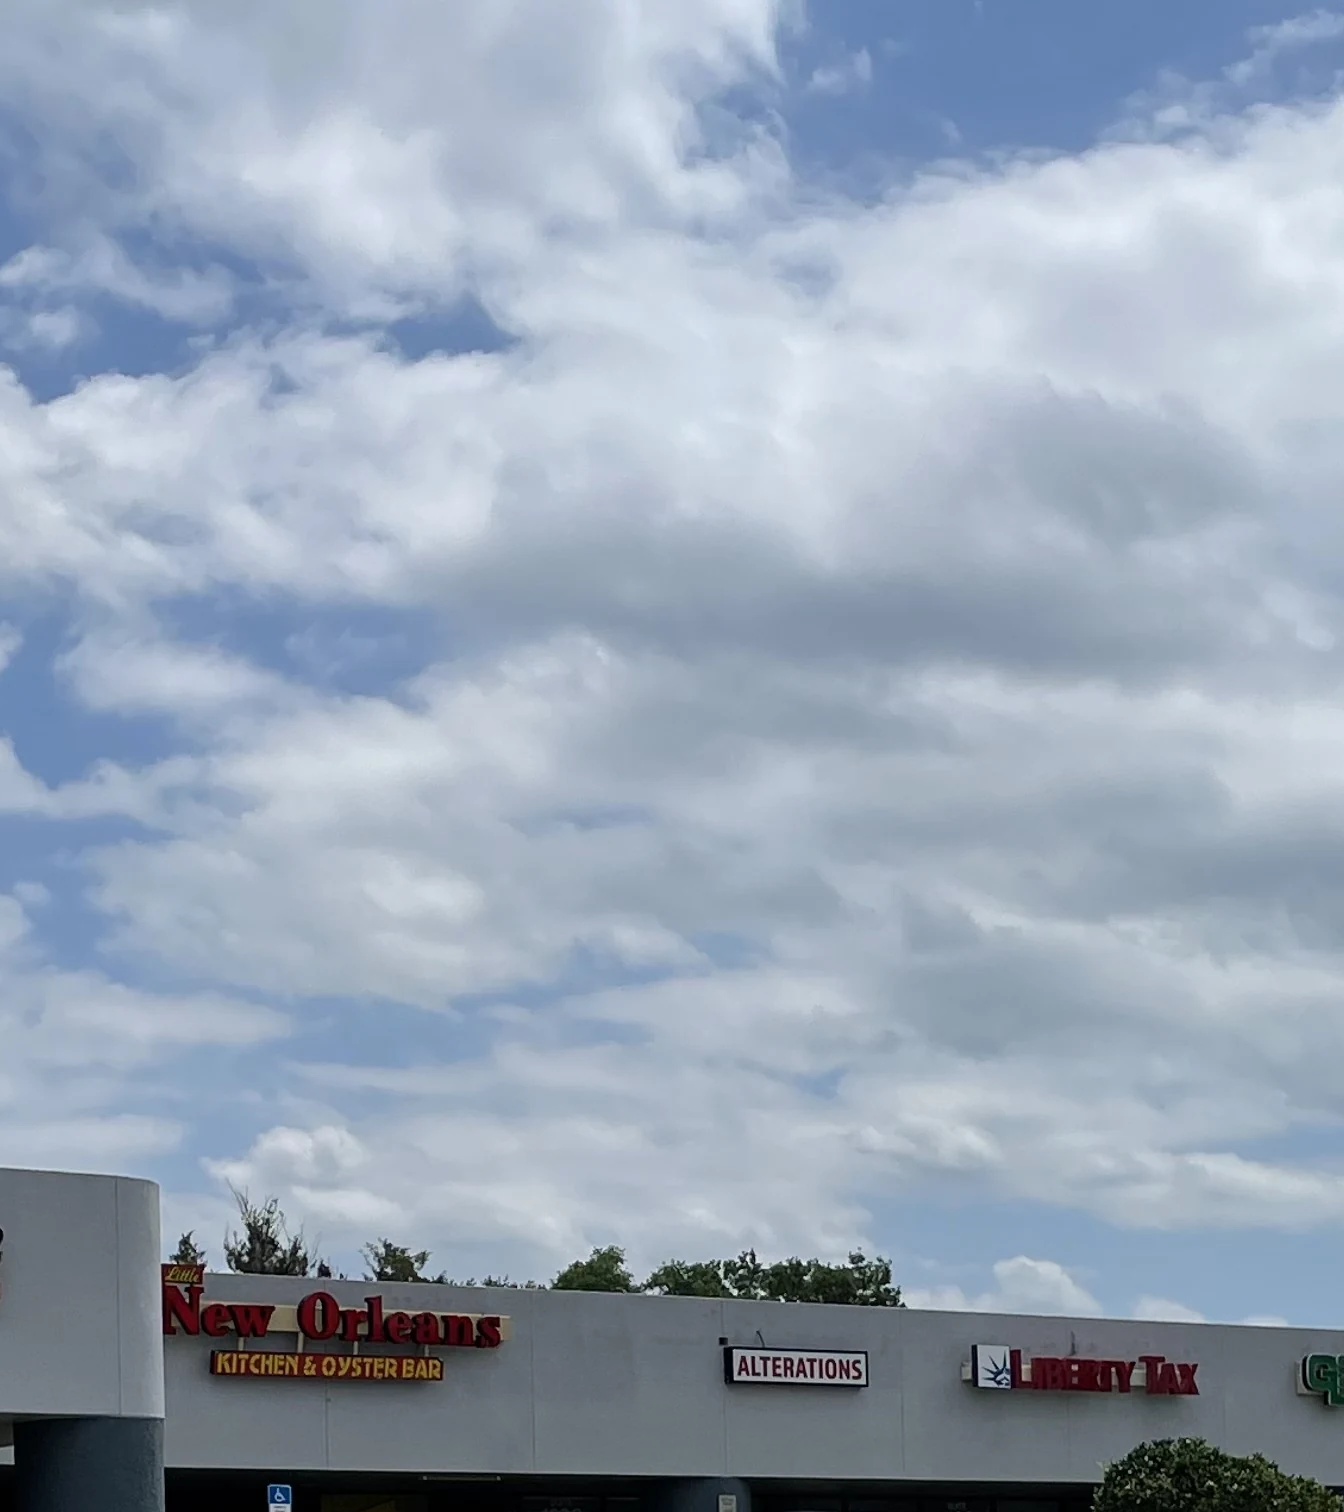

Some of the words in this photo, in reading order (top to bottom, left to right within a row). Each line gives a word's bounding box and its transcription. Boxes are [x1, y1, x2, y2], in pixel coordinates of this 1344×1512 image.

[163, 1265, 201, 1283] Little
[162, 1285, 275, 1337] New
[297, 1291, 502, 1348] Orleans
[216, 1352, 298, 1377] KITCHEN
[303, 1357, 317, 1376] &
[321, 1358, 397, 1380] OYSTER
[402, 1359, 443, 1381] BAR
[737, 1354, 863, 1381] ALTERATIONS
